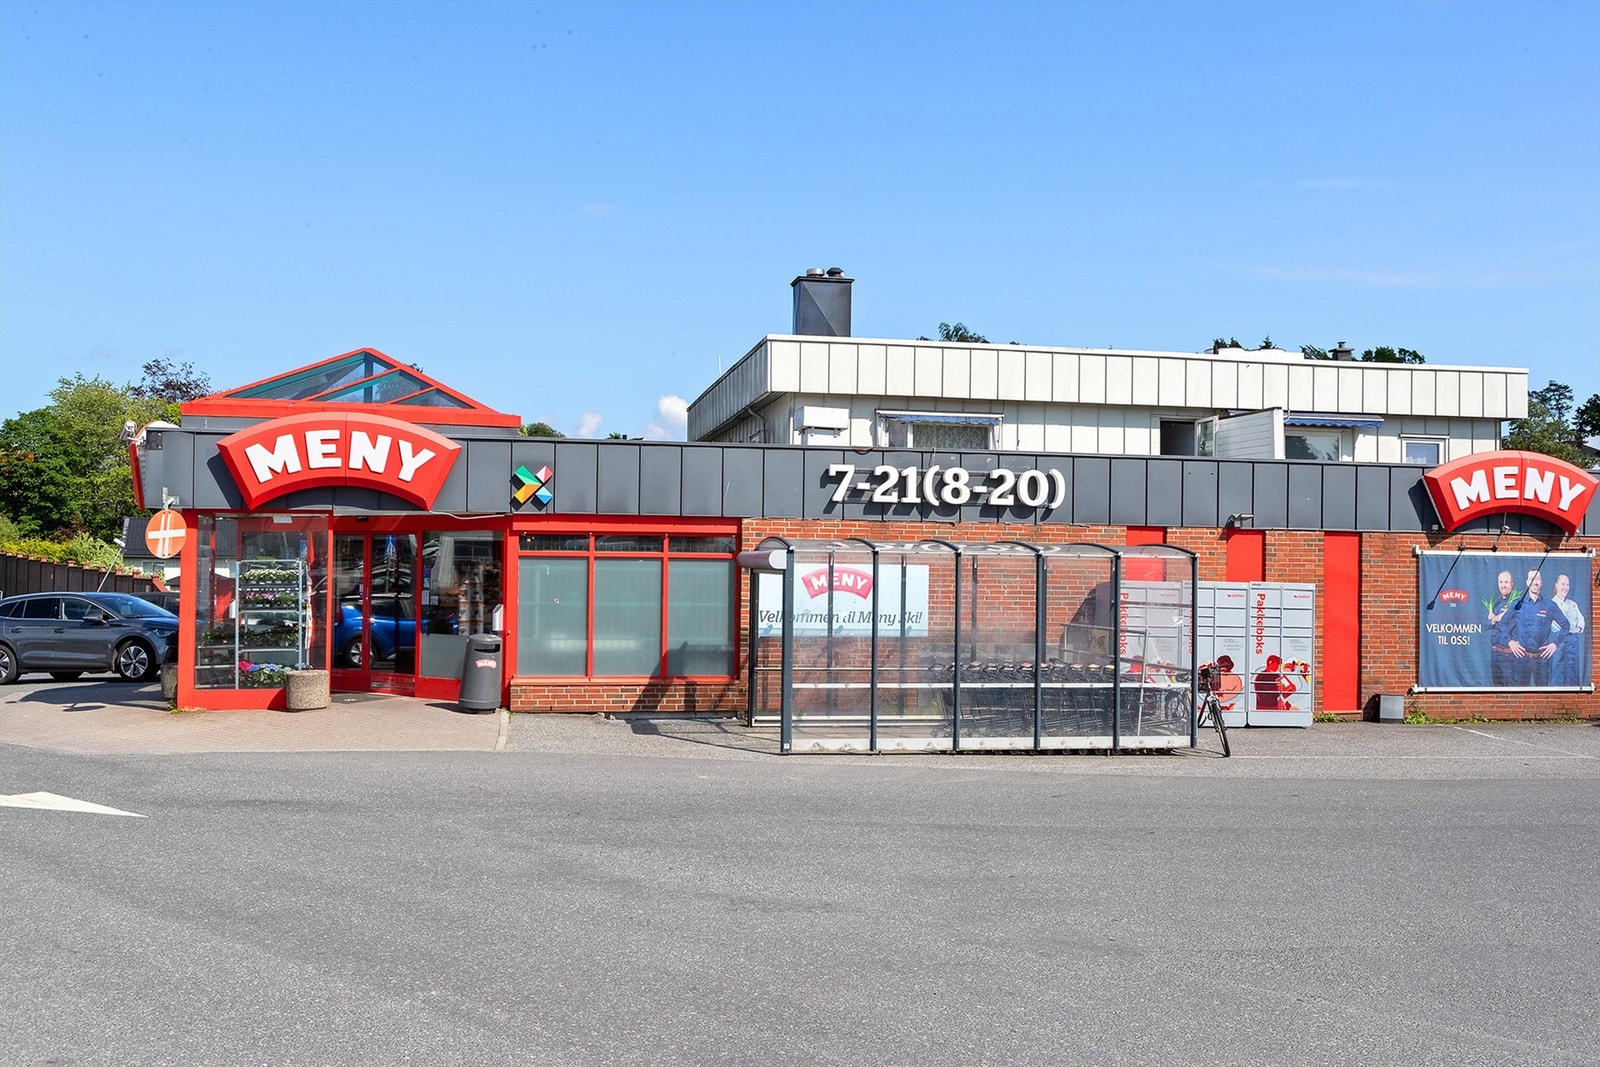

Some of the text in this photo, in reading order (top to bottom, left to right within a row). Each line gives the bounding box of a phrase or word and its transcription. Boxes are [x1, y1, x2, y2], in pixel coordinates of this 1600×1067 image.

[244, 429, 437, 484] MENY
[828, 463, 1066, 509] 7-21(8-20)
[1450, 466, 1587, 512] MENY
[810, 572, 868, 591] MENY
[1442, 591, 1466, 601] MENY
[759, 610, 840, 624] Velmmen
[857, 611, 897, 626] Mny
[1255, 593, 1266, 654] Pakkeboks
[1425, 623, 1482, 634] VELKOMMEN
[1437, 635, 1471, 646] TIL OSS!
